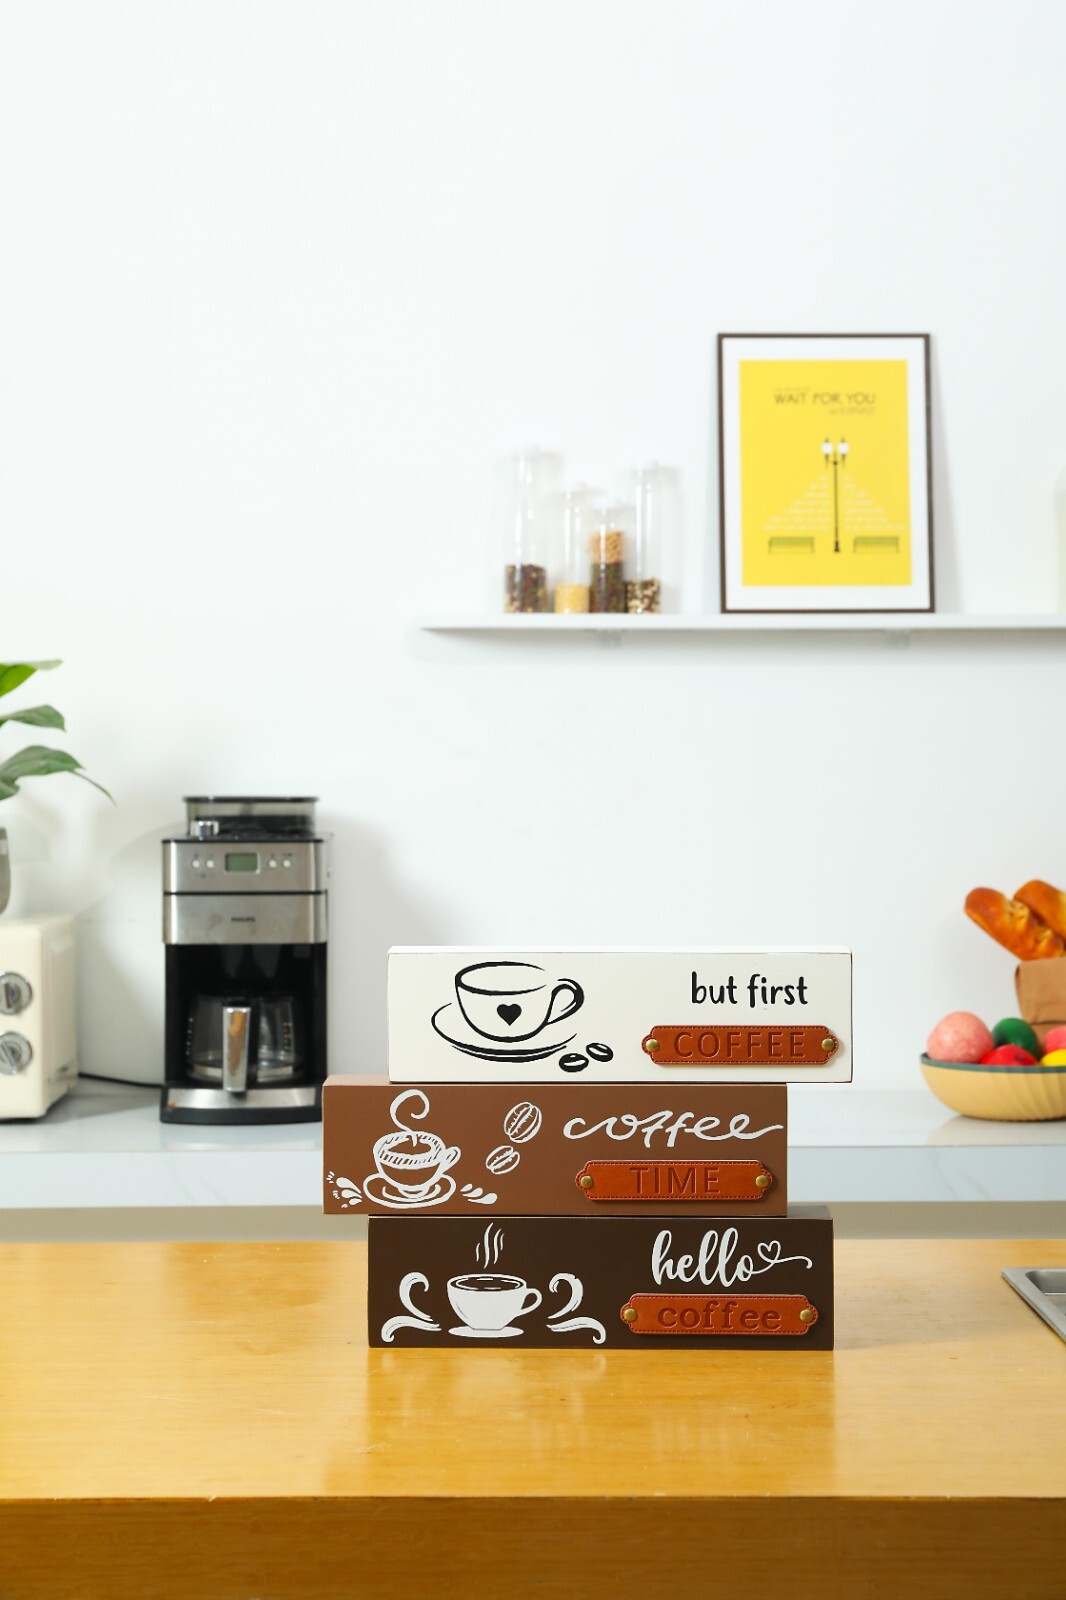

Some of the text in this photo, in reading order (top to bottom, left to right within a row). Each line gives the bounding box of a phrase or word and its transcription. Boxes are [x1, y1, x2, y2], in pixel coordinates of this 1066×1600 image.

[773, 391, 876, 405] WAIT FOR YOU
[691, 971, 808, 1008] but first
[674, 1031, 805, 1058] COFFEE
[563, 1110, 784, 1148] coffee
[629, 1166, 720, 1194] TIME
[651, 1227, 754, 1287] hello
[657, 1300, 782, 1330] coffee
